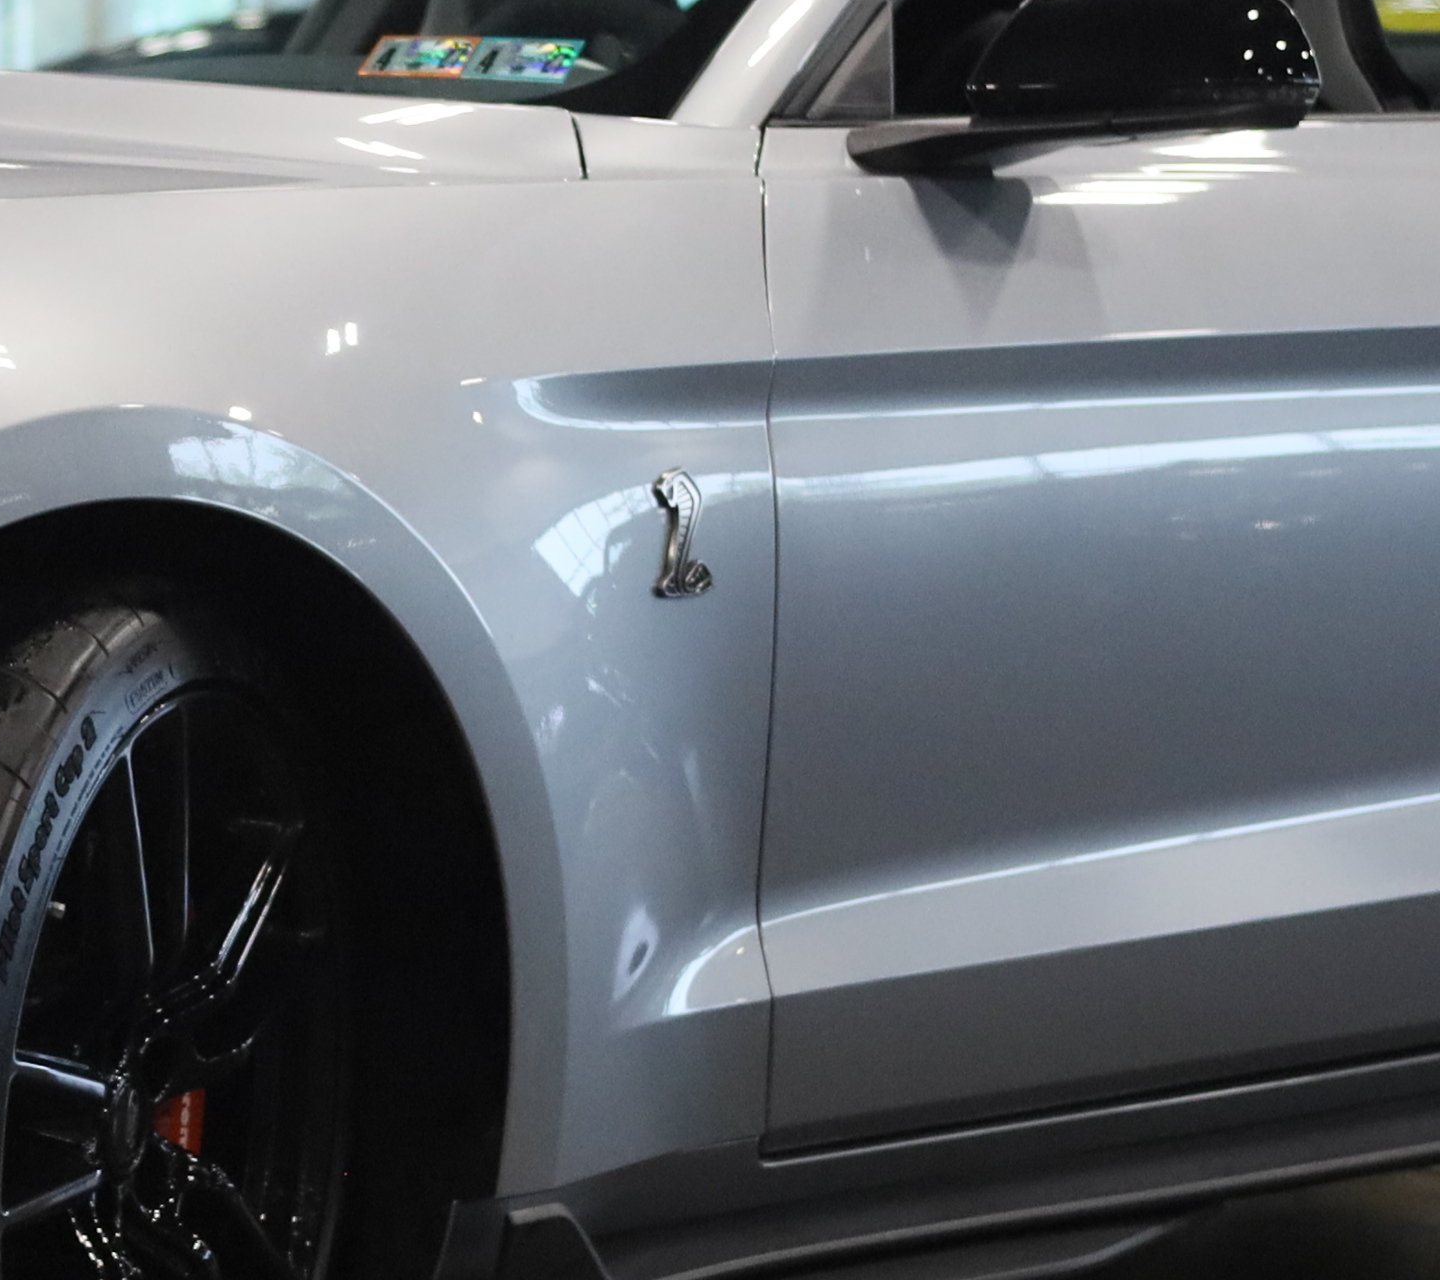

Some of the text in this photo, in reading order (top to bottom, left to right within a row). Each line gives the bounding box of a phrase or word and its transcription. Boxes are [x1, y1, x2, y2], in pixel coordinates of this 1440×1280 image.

[18, 790, 60, 895] Sport
[54, 743, 85, 798] Cup
[79, 715, 97, 752] 2
